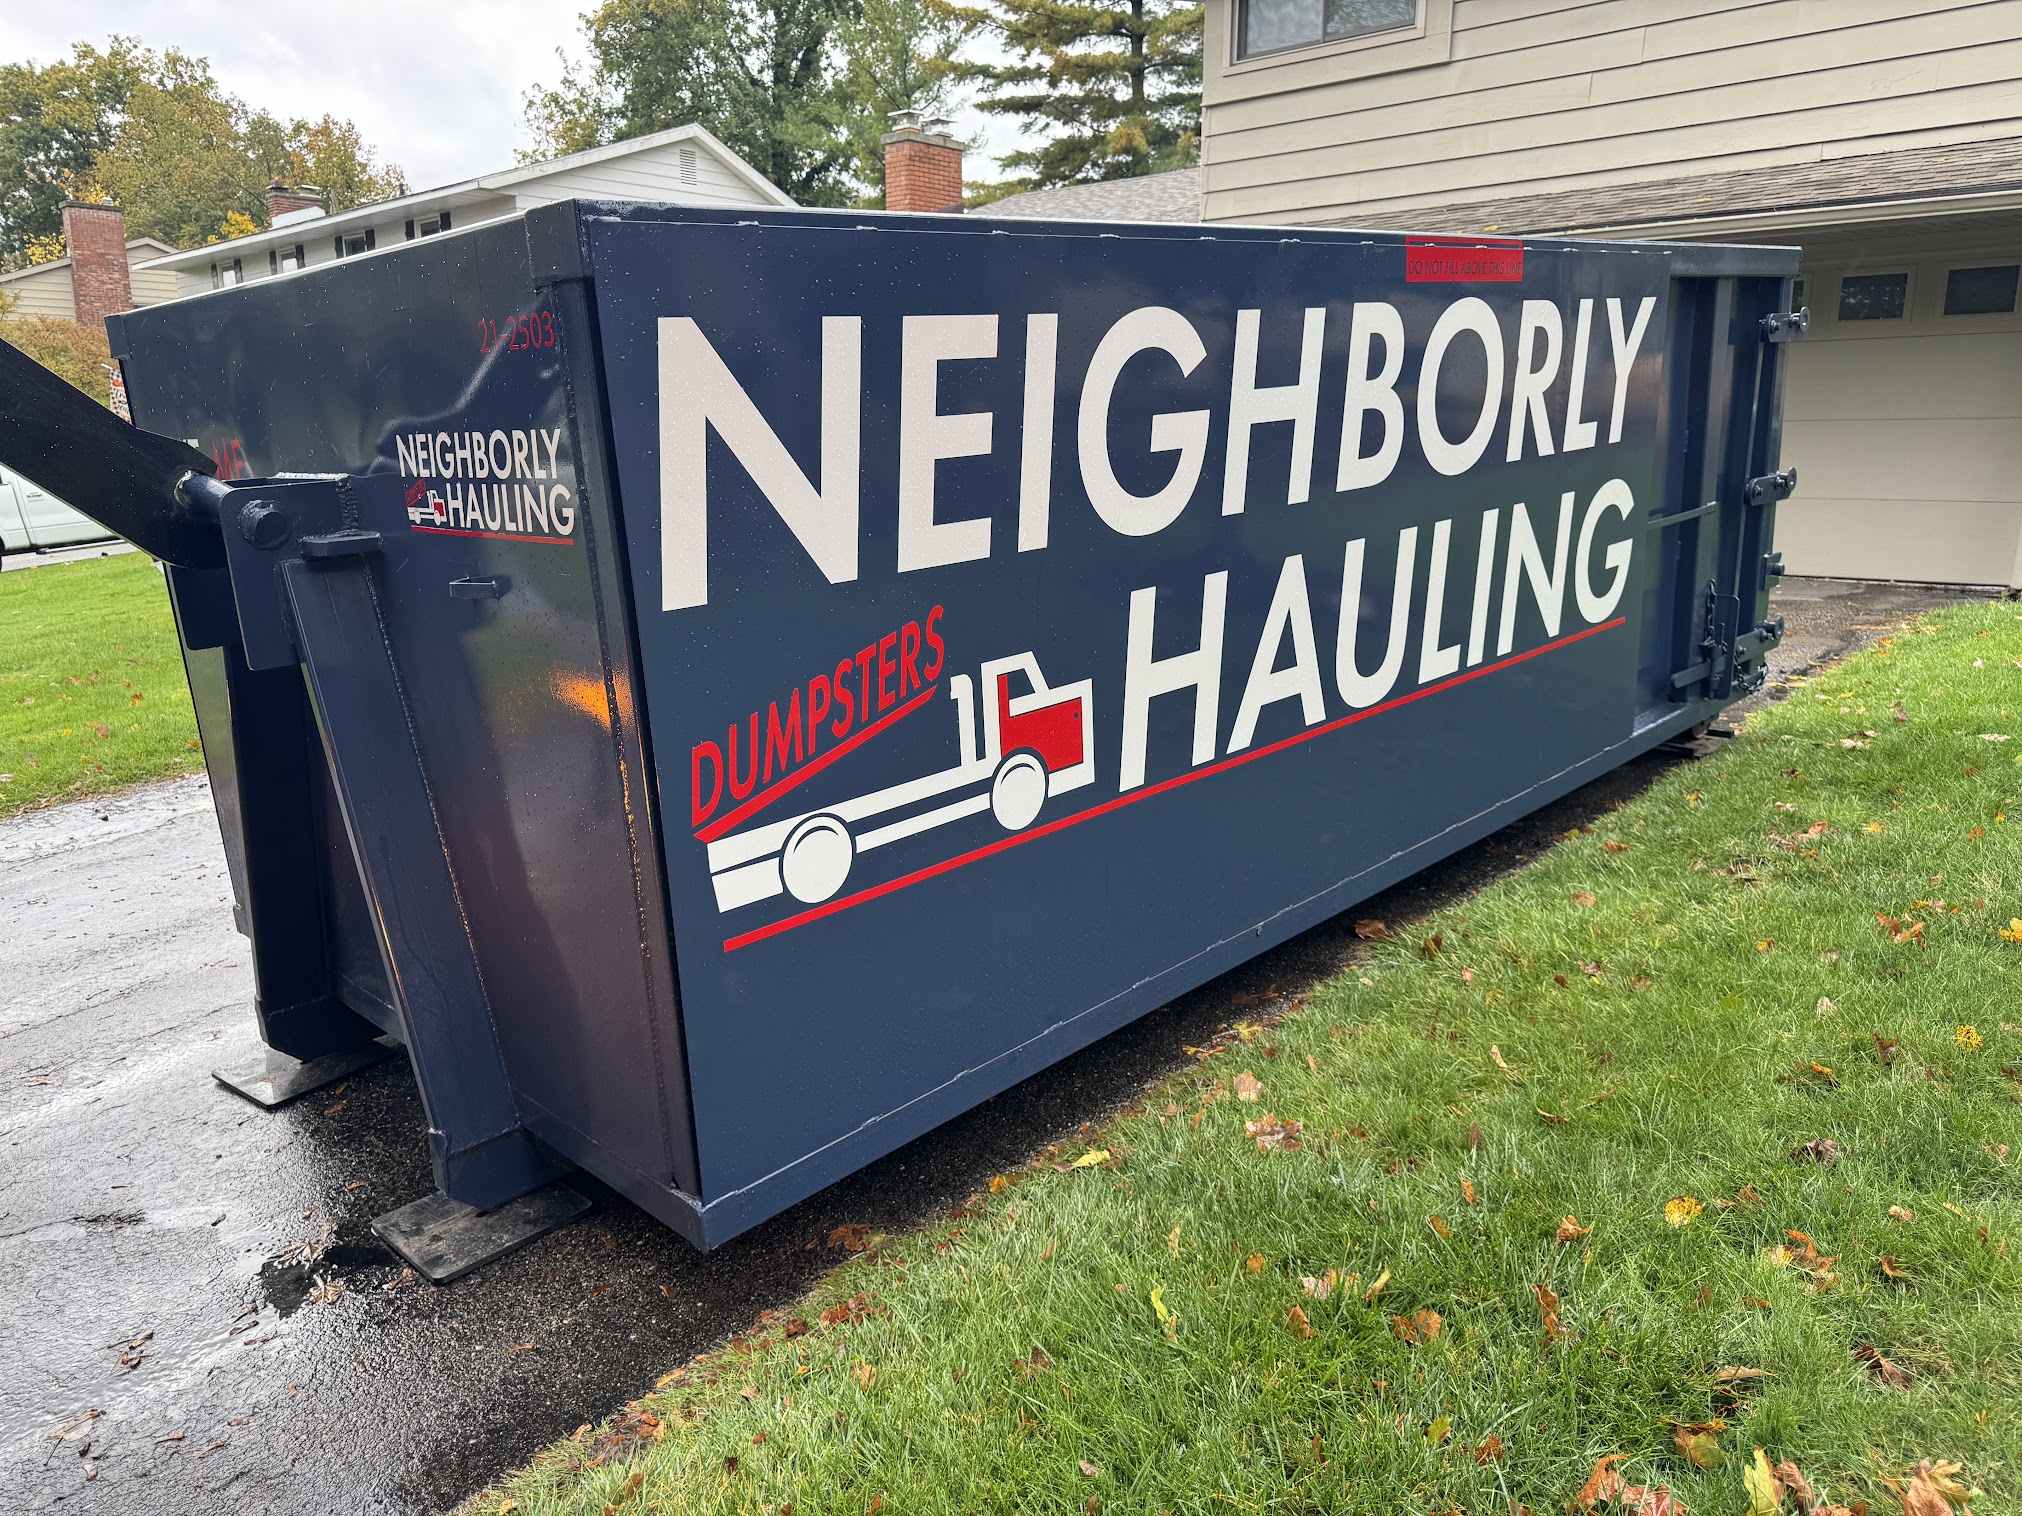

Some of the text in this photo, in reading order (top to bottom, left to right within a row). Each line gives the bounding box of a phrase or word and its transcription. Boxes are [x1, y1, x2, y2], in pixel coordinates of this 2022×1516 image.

[1409, 261, 1521, 275] DO NOT FILL ABOVE THIS LINE
[478, 311, 554, 353] 21-2503
[396, 429, 560, 479] NEIGHBORLY
[658, 297, 1656, 611] NEIGHBORLY
[446, 482, 574, 535] HAULING
[1119, 478, 1634, 792] HAULING
[692, 605, 945, 827] DUMPSTERS
